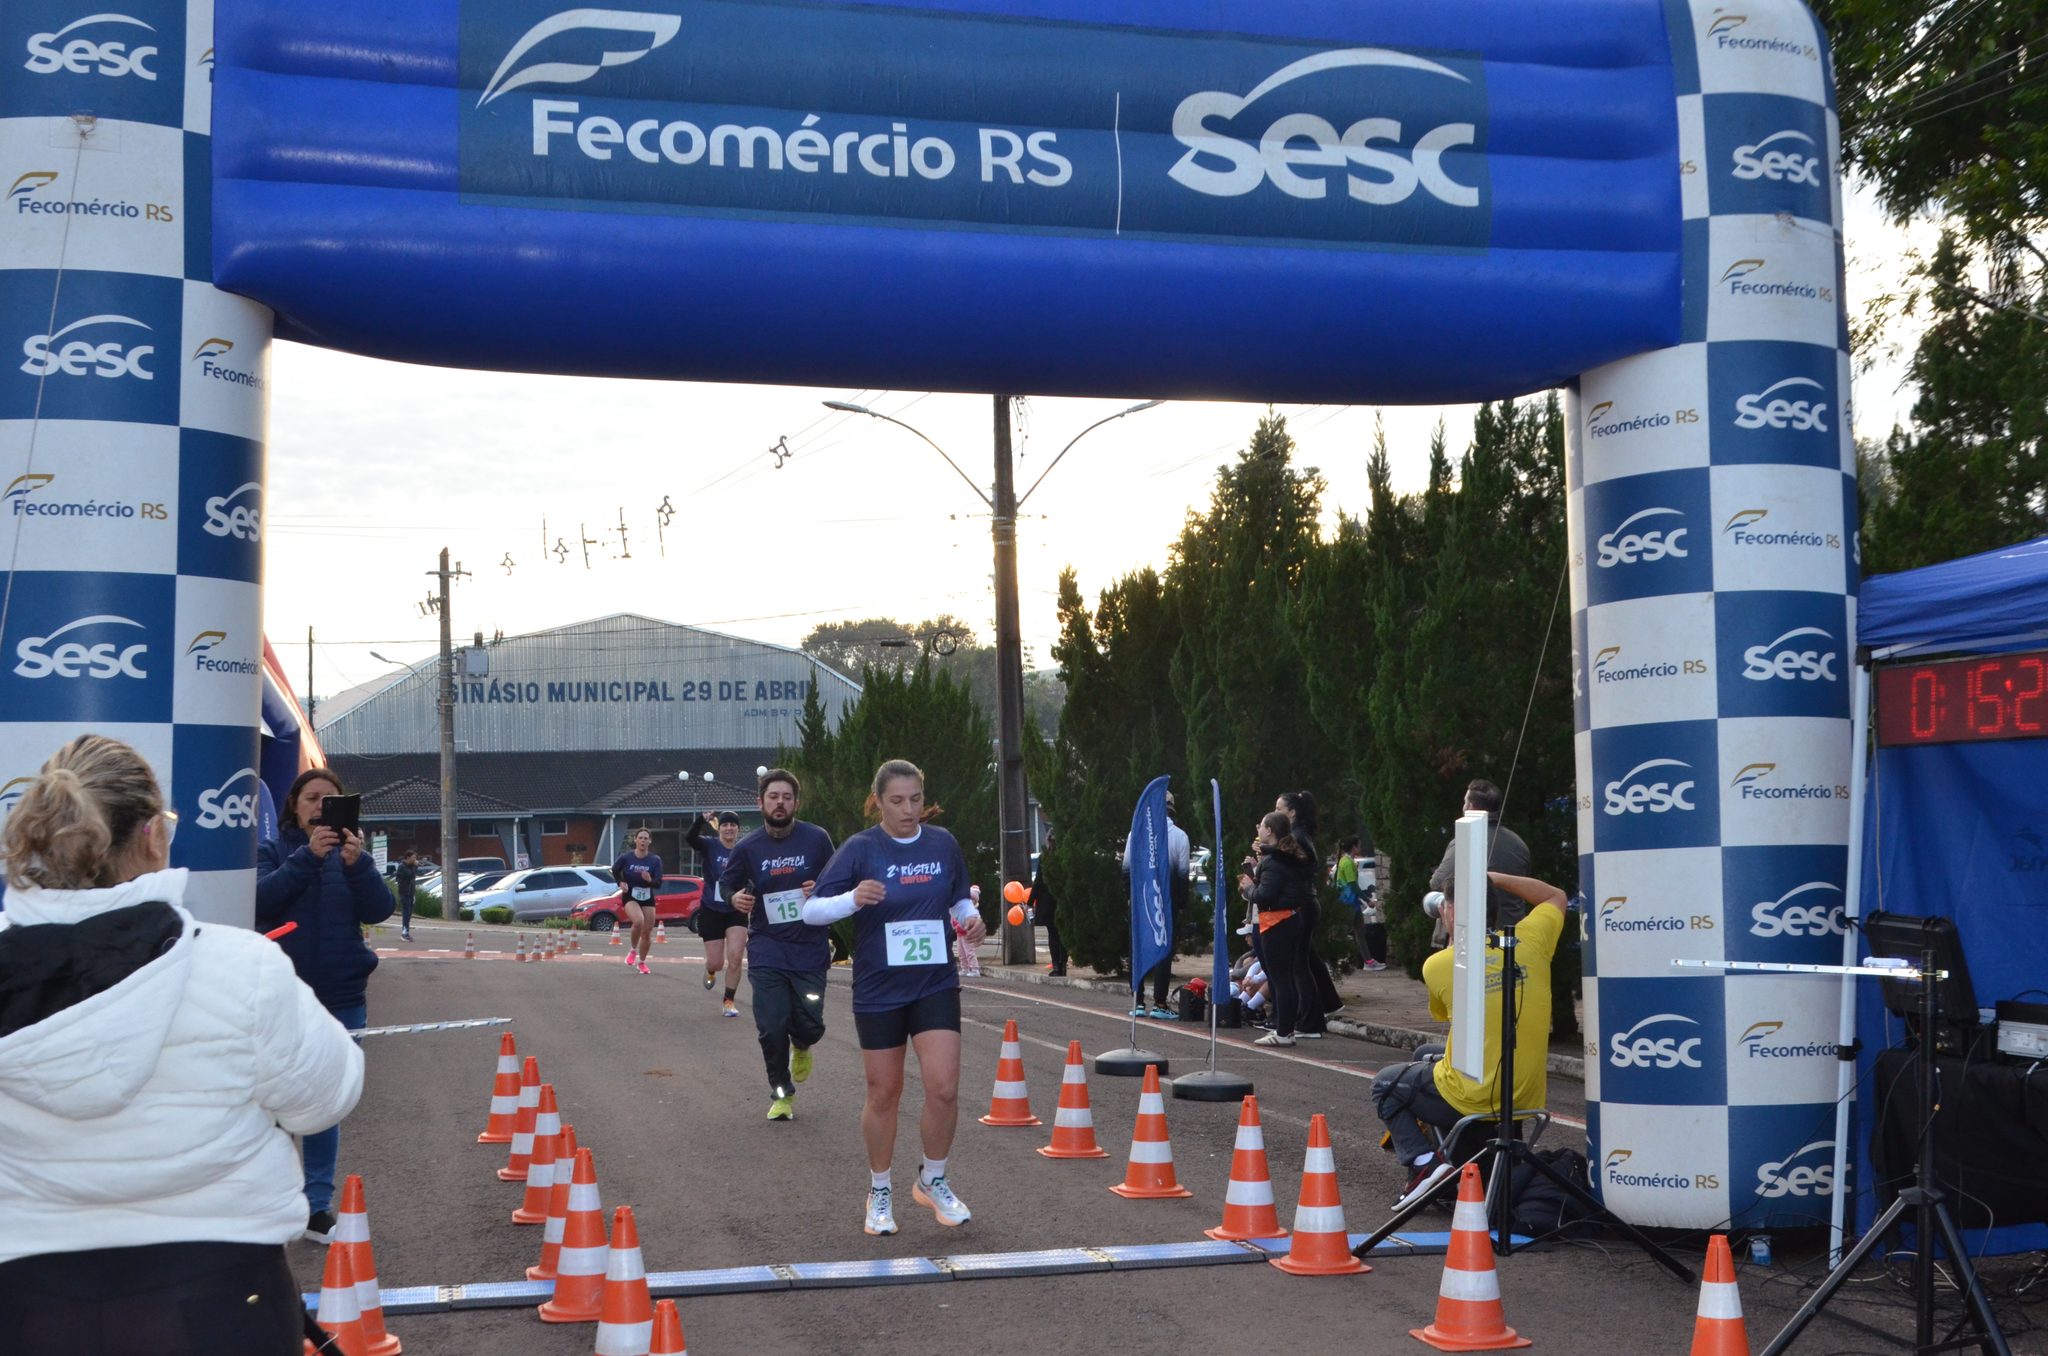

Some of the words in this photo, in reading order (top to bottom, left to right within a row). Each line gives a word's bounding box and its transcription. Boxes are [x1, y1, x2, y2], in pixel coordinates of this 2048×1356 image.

[24, 32, 157, 81] Sesc
[532, 98, 956, 182] Fecomércio
[980, 128, 1073, 188] RS
[1167, 91, 1479, 208] Sesc
[1731, 145, 1820, 187] Sesc
[18, 197, 139, 218] Fecomércio
[145, 204, 173, 222] RS
[1730, 280, 1816, 300] Fecomércio
[20, 334, 154, 380] Sesc
[1591, 413, 1671, 440] Fecomércio
[1675, 408, 1700, 424] RS
[1734, 394, 1828, 433] Sesc
[13, 499, 134, 518] Fecomércio
[140, 503, 168, 520] RS
[1596, 527, 1688, 569] Sesc
[1734, 531, 1823, 547] Fecomércio
[1826, 534, 1841, 550] RS
[13, 637, 147, 680] Sesc
[1598, 662, 1678, 684] Fecomércio
[1683, 659, 1707, 675] RS
[1741, 645, 1837, 682] Sesc
[548, 680, 675, 703] MUNICIPAL
[683, 680, 712, 702] 29
[719, 680, 747, 702] DE
[1603, 780, 1695, 816] Sesc
[1742, 784, 1832, 801] Fecomércio
[1835, 785, 1849, 800] RS
[777, 902, 799, 920] 15
[1604, 916, 1685, 933] Fecomércio
[1690, 916, 1715, 931] RS
[903, 937, 932, 962] 25
[1609, 1032, 1702, 1069] Sesc
[1609, 1170, 1690, 1190] Fecomércio
[1695, 1175, 1720, 1190] RS
